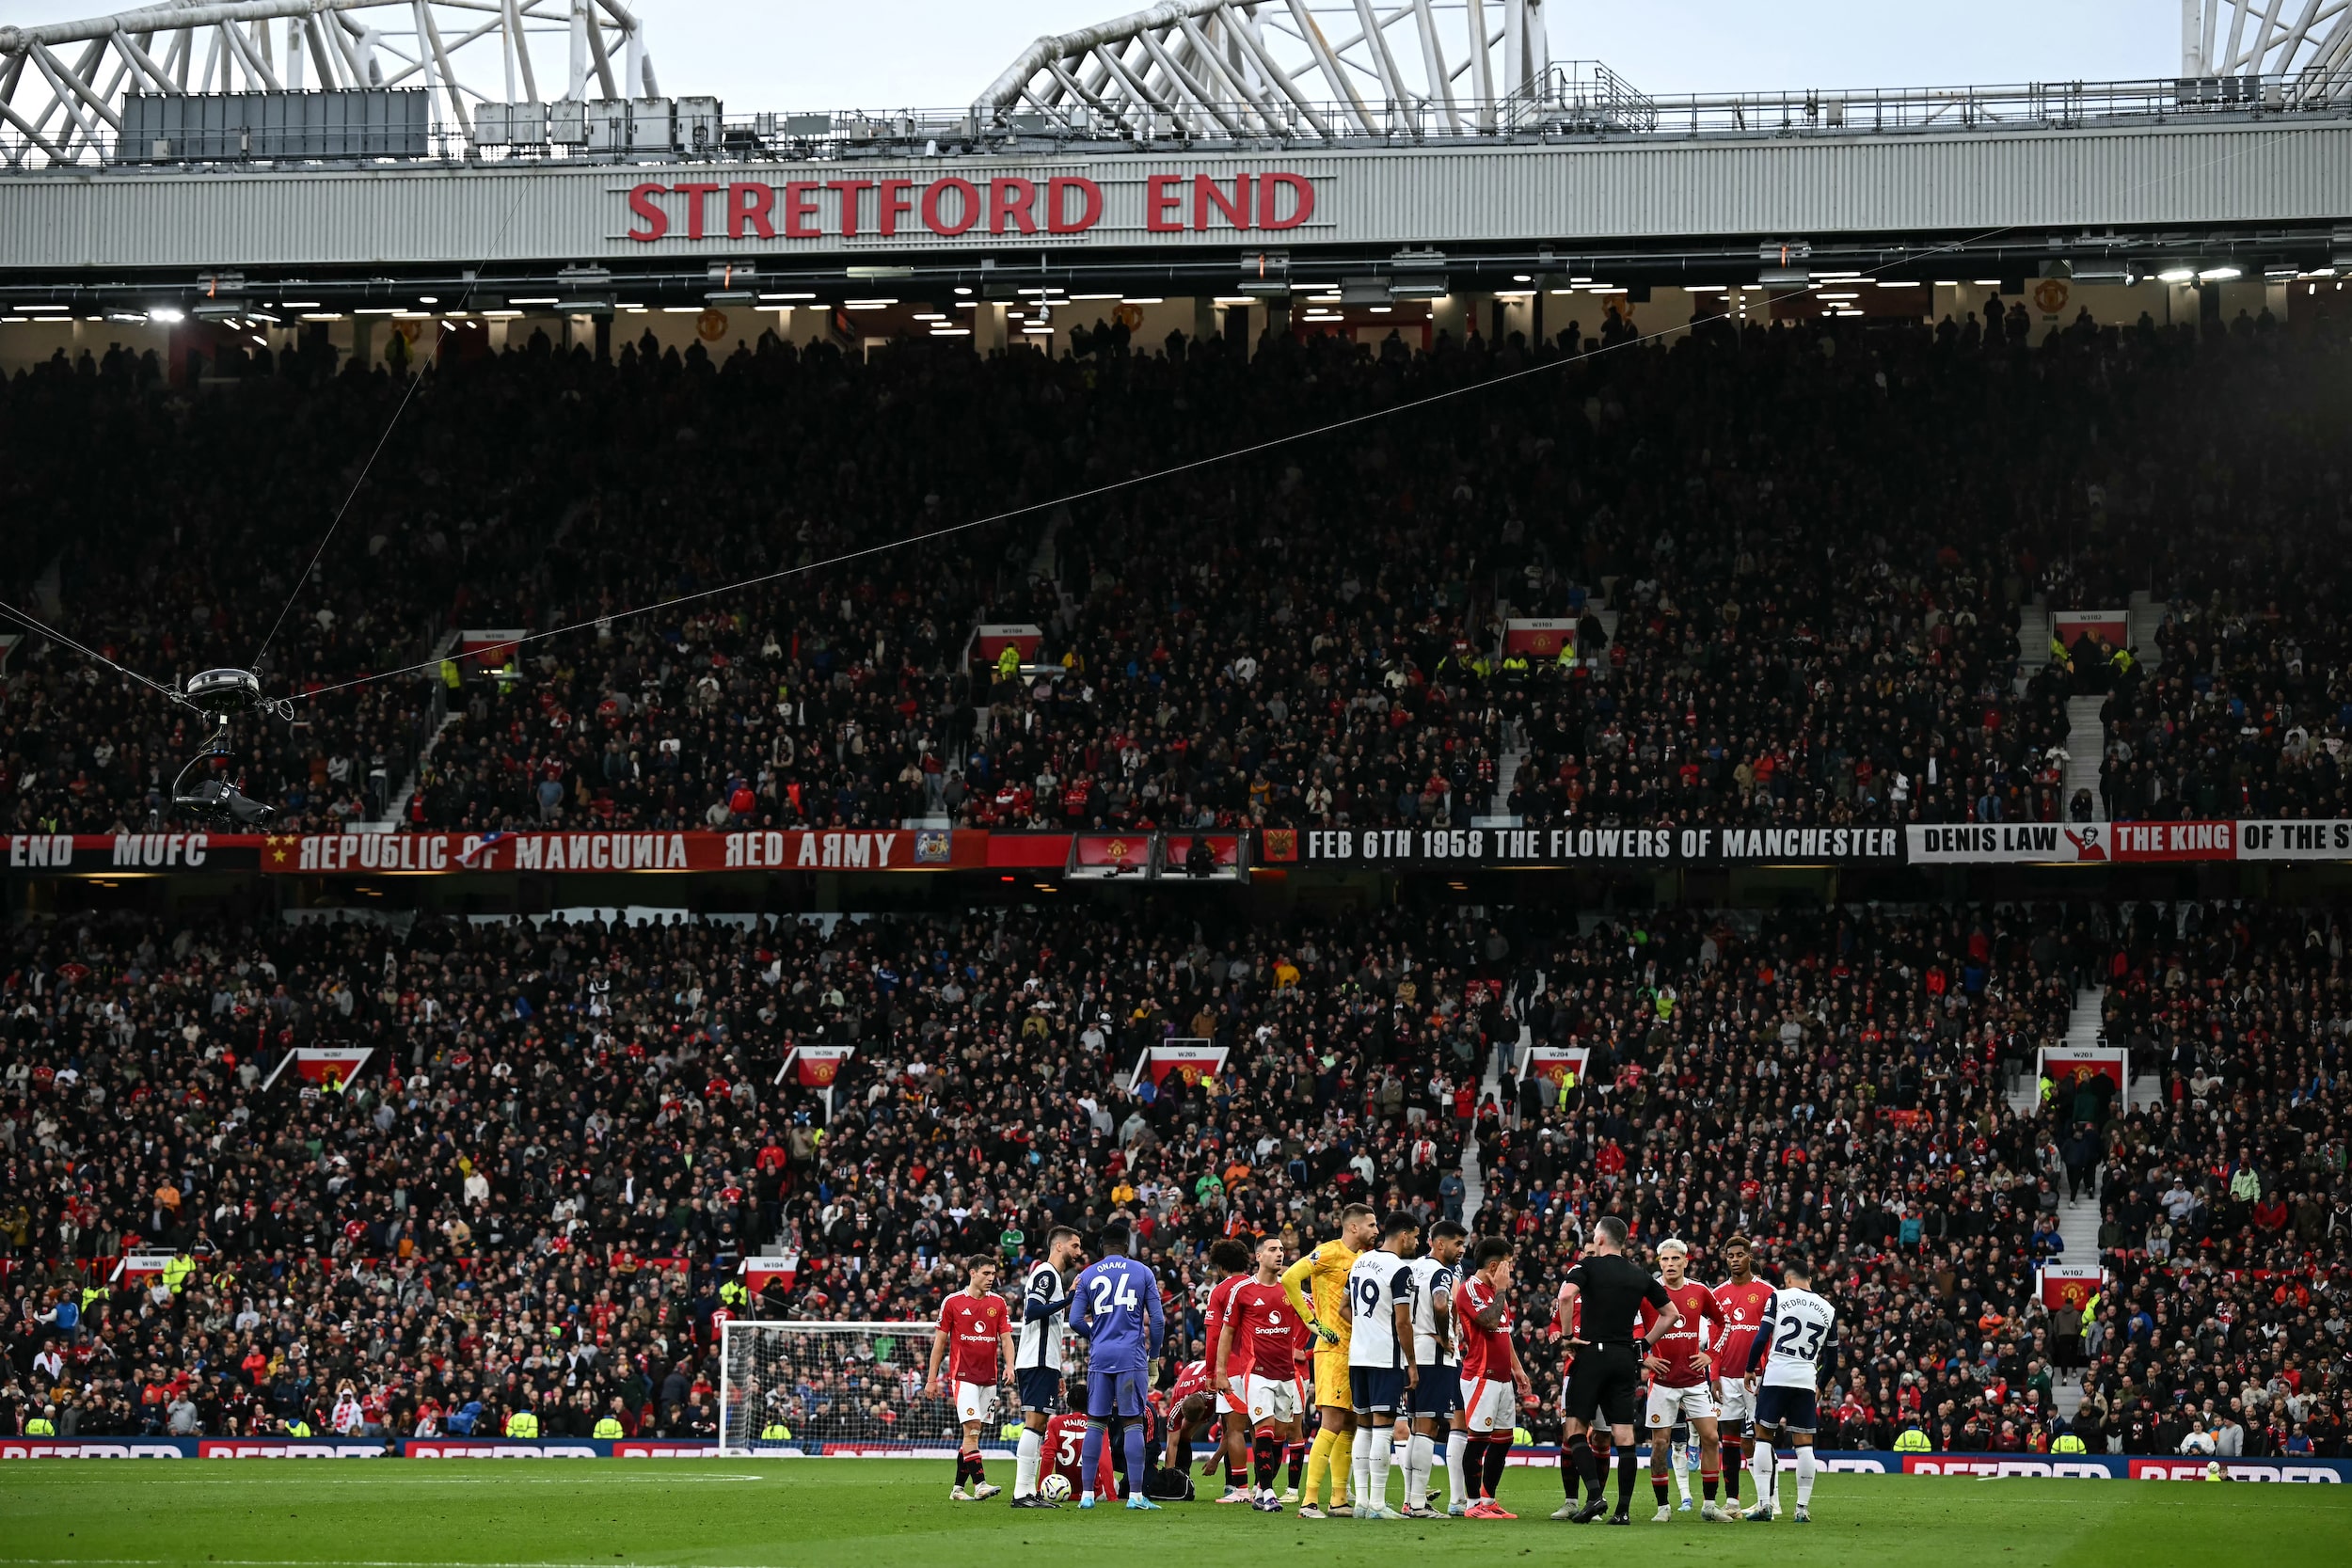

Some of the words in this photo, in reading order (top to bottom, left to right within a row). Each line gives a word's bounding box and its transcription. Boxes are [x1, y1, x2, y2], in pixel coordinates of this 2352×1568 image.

[628, 175, 1103, 242] STRETFORD
[1147, 171, 1315, 232] END
[10, 834, 73, 867] END
[113, 834, 207, 866] MUFC
[1308, 831, 1353, 859] FEB
[1362, 831, 1411, 859] 6TH
[1422, 831, 1484, 858] 1958
[1495, 831, 1539, 858] THE
[1550, 830, 1668, 858] FLOWERS
[1681, 830, 1712, 857] OF
[1722, 829, 1898, 857] MANCHESTER
[1924, 827, 1997, 852] DENIS
[2003, 827, 2058, 852] LAW
[2117, 825, 2165, 852] THE
[2169, 824, 2230, 850] KING
[2244, 825, 2274, 850] OF
[2280, 825, 2327, 850] THE
[2334, 824, 2352, 849] S
[1097, 1261, 1127, 1273] ONANA
[1090, 1273, 1138, 1315] 24
[1351, 1275, 1380, 1319] 19
[1780, 1298, 1807, 1312] PEDRO
[1809, 1301, 1831, 1329] PORRO
[961, 1333, 996, 1342] Snapdragon
[1661, 1331, 1698, 1339] napdragon
[1774, 1316, 1825, 1361] 23
